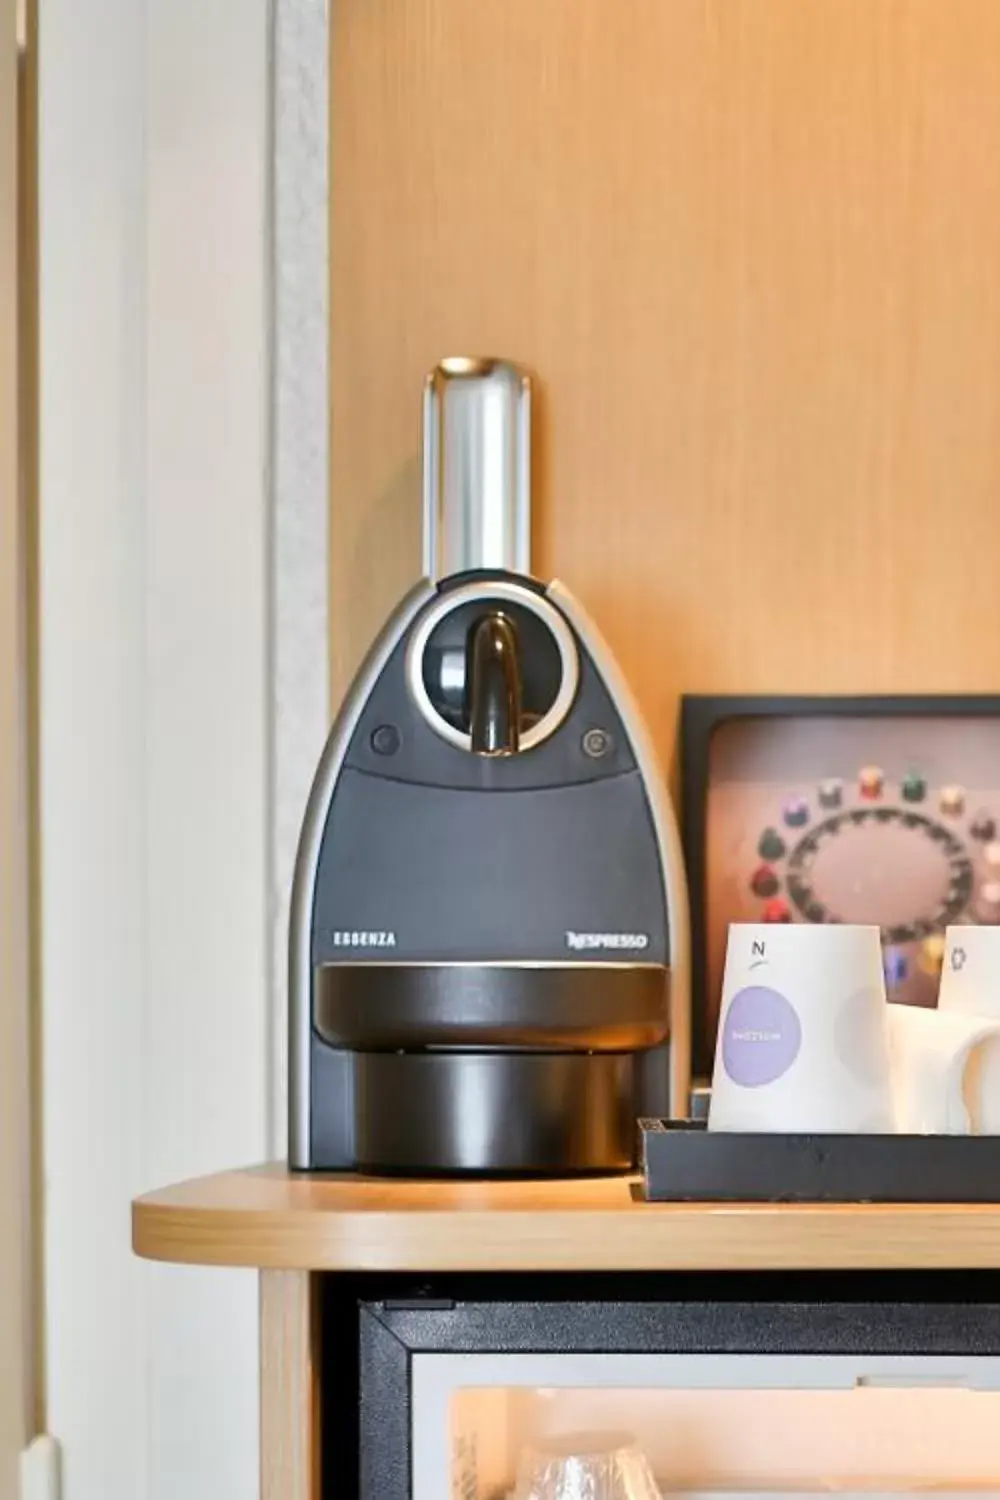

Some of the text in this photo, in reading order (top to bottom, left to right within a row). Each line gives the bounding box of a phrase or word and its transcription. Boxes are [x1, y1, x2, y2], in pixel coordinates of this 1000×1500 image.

[333, 931, 396, 947] ESSENZA
[566, 931, 649, 949] NESPRESSO
[751, 941, 766, 956] N
